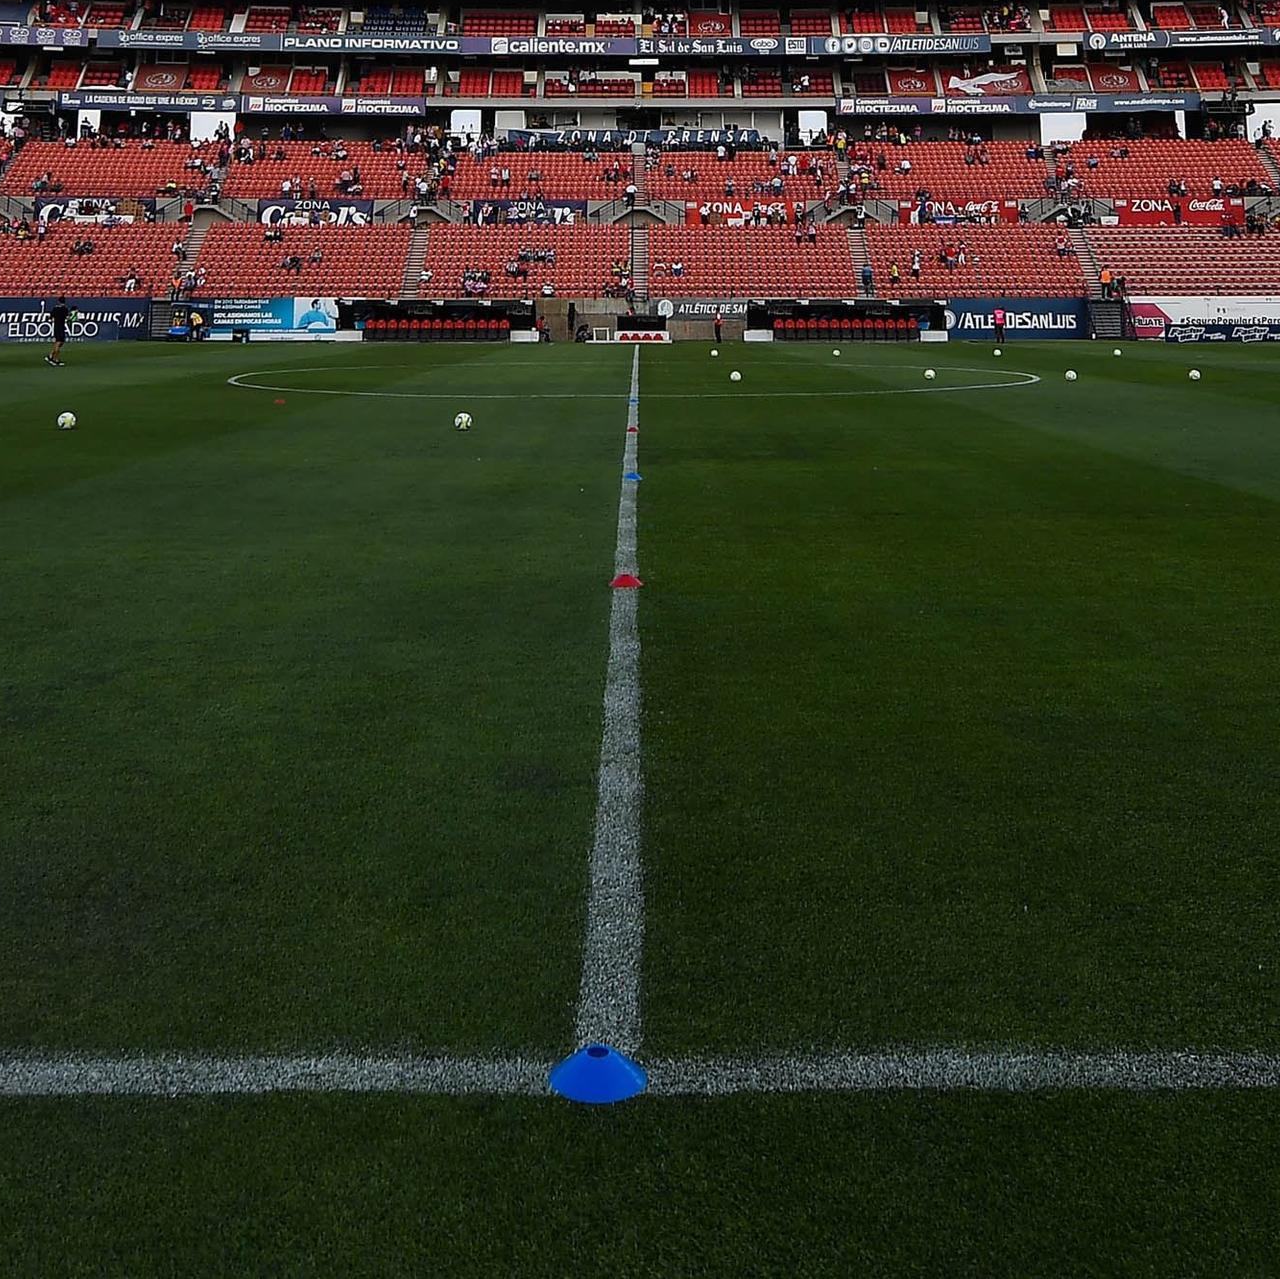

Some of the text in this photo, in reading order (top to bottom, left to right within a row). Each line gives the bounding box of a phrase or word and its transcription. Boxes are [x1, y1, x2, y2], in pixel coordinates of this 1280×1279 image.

[130, 34, 154, 42] office
[156, 34, 183, 43] expres
[208, 34, 261, 44] office expres
[1110, 32, 1156, 43] ANTENA
[284, 38, 458, 50] PLANO INFORMATIVO
[510, 38, 606, 54] caliente.mx
[639, 39, 743, 53] El Sol de San Luis
[889, 37, 979, 52] /ATLETIDESANLUIS
[84, 95, 93, 104] LA
[94, 95, 117, 104] CADENA
[118, 96, 126, 104] DE
[126, 96, 144, 104] RADIO
[1114, 97, 1185, 106] www.mediotiempo.com
[264, 103, 328, 112] MOCTEZUMA
[356, 104, 421, 114] MOCTEZUMA
[855, 104, 918, 113] MOCTEZUMA
[946, 104, 1010, 113] MOCTEZUMA
[557, 130, 751, 143] ZONA PRENSA
[295, 200, 331, 209] ZONA
[1131, 199, 1173, 212] ZONA
[679, 302, 717, 313] ATLÉTICO
[720, 304, 731, 313] DE
[958, 312, 1077, 329] /ATLEDESANLUIS
